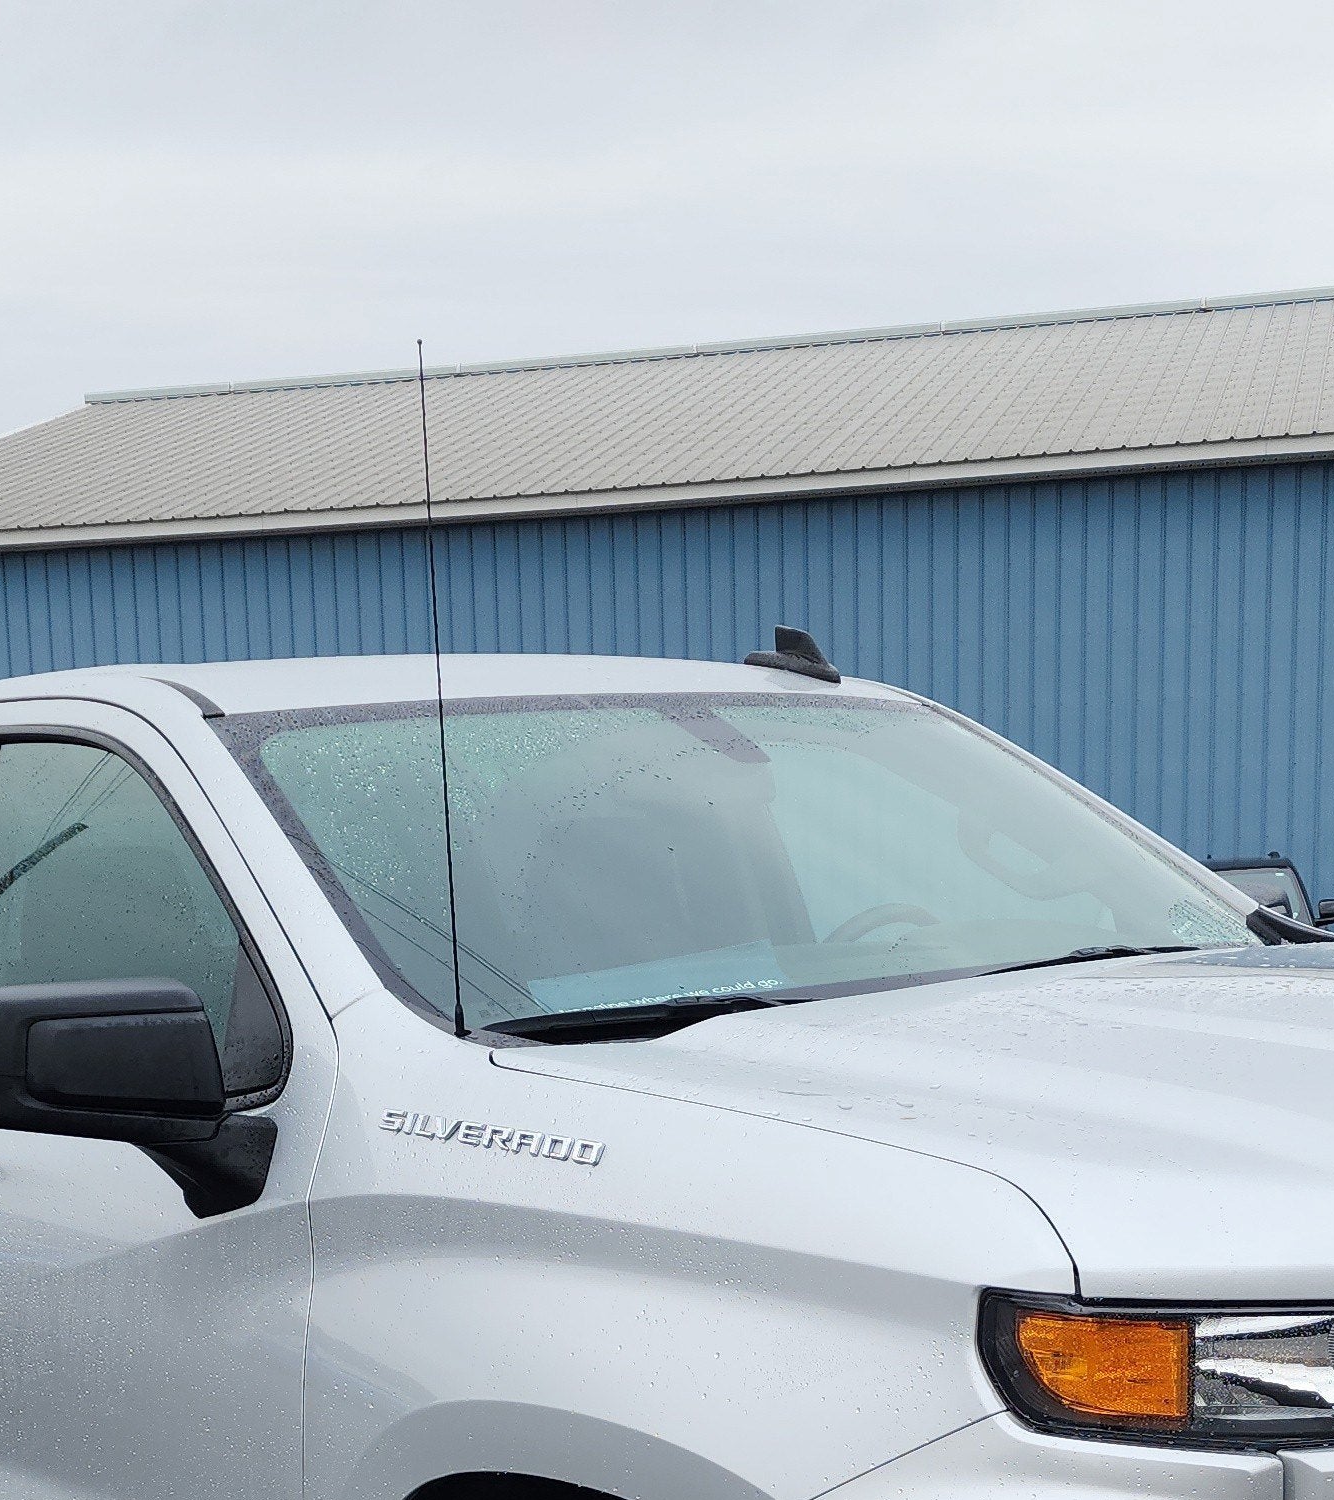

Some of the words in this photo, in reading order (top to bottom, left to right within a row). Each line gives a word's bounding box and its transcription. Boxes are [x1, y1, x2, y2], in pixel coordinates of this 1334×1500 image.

[712, 981, 756, 994] could
[758, 978, 783, 989] go.
[378, 1107, 606, 1166] SILVERADO
